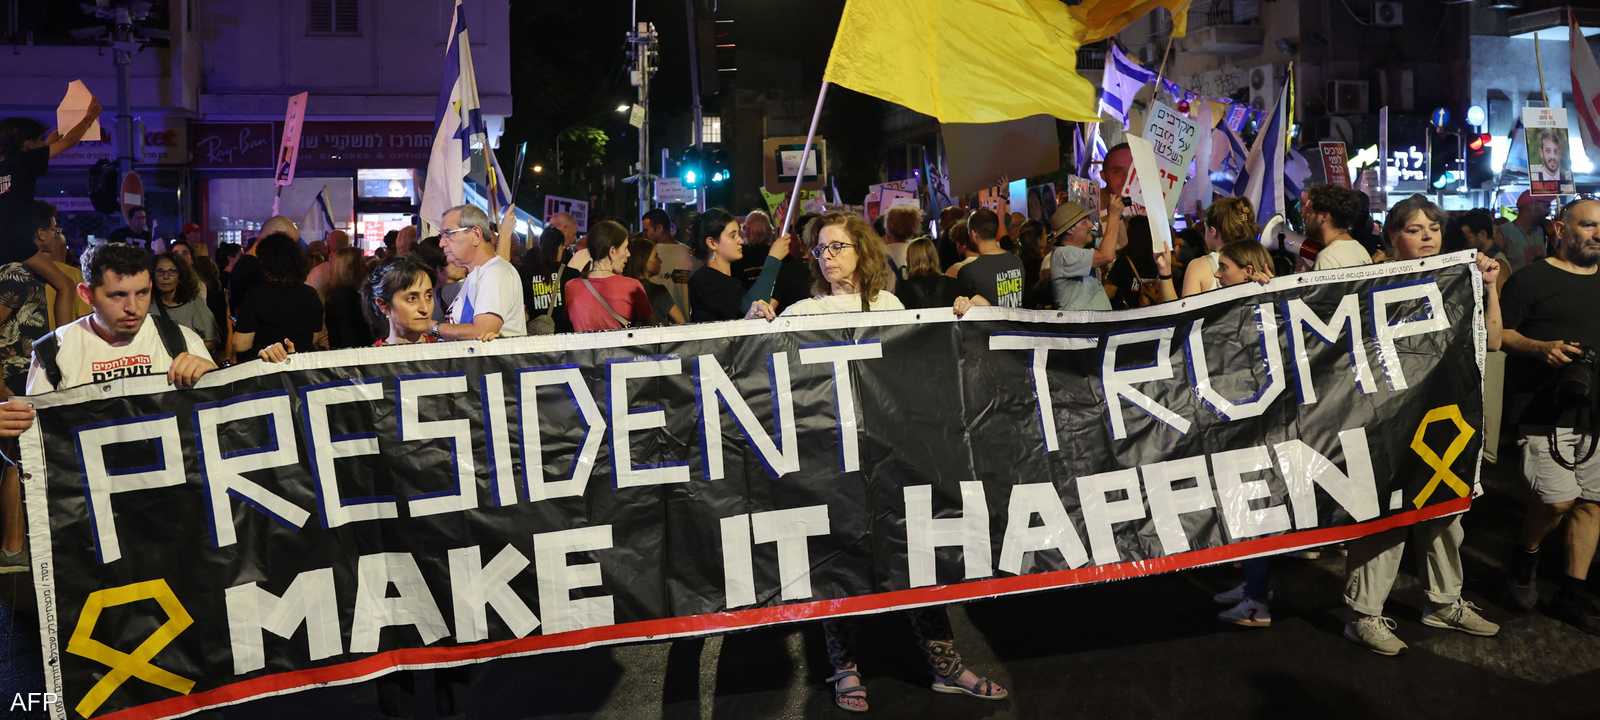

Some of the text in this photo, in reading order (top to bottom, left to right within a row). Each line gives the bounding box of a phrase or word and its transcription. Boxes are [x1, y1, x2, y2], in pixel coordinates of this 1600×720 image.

[1157, 109, 1195, 137] מקרבים
[196, 127, 272, 164] Ray-Ban
[323, 132, 384, 150] למשקפי
[1150, 123, 1190, 152] על מזבח
[1154, 140, 1183, 165] השלטון
[997, 278, 1022, 296] HOME!
[92, 365, 152, 383] זועקים
[93, 357, 129, 371] לוחמים
[76, 279, 1451, 563] PRESIDENT TRUMP
[225, 427, 1402, 675] MAKE IT HAPPEN.
